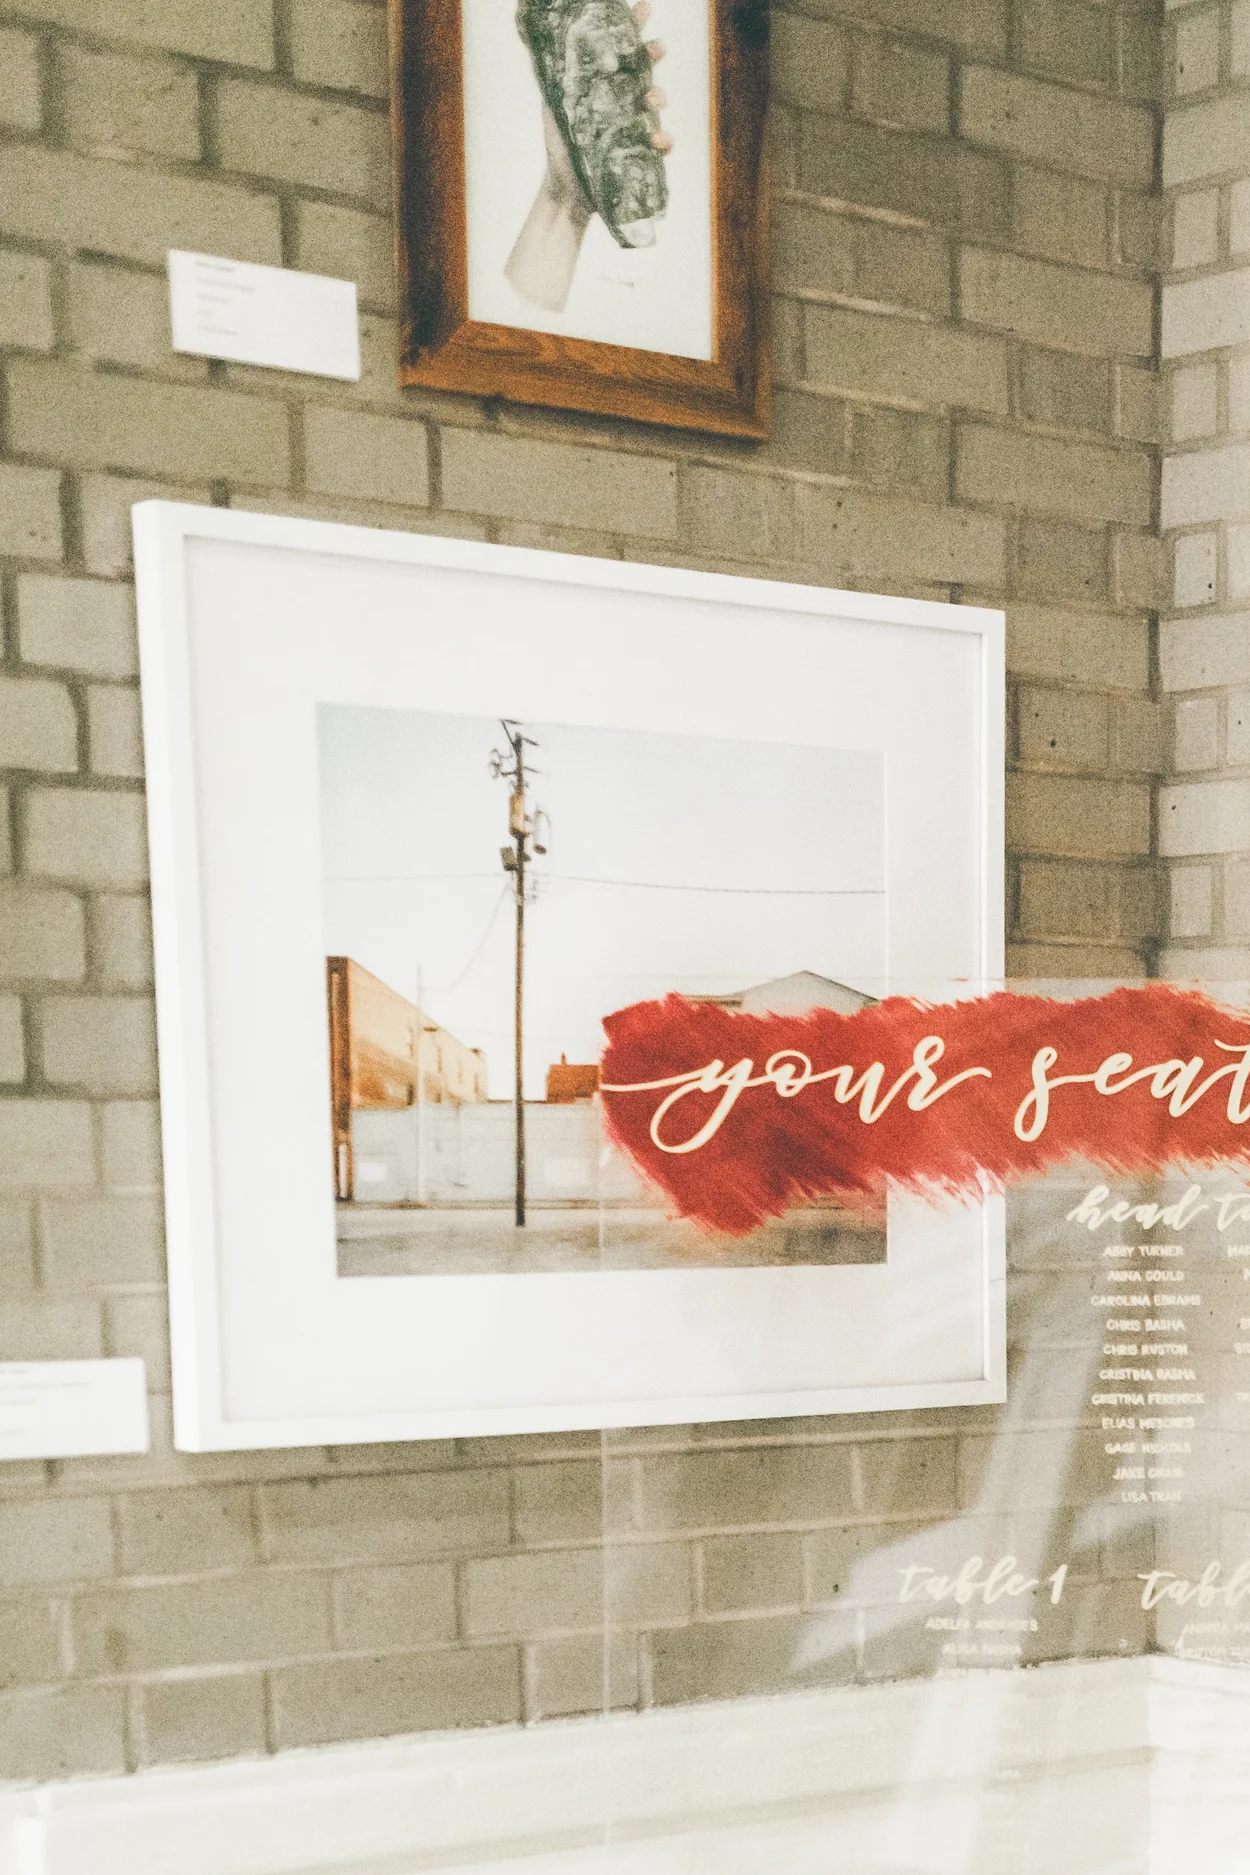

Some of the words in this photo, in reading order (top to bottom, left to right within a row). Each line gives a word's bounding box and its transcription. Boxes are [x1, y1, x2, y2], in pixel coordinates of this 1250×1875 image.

[601, 1036, 992, 1152] your
[1066, 1184, 1210, 1231] head
[1103, 1246, 1134, 1257] ABBY
[1138, 1245, 1184, 1256] TURNER
[1108, 1271, 1142, 1282] ANNA
[1146, 1270, 1184, 1281] GOULD
[1090, 1295, 1150, 1306] CAROLINA
[1106, 1319, 1140, 1331] CHRIS
[1145, 1319, 1185, 1331] BASHA
[1103, 1344, 1137, 1355] CHRIS
[1099, 1369, 1153, 1381] CRISTINA
[1092, 1394, 1144, 1406] CRISTINA
[1102, 1417, 1135, 1429] ELIAS
[1113, 1467, 1145, 1480] JAKE
[896, 1555, 1039, 1605] table
[1048, 1563, 1068, 1605] 1
